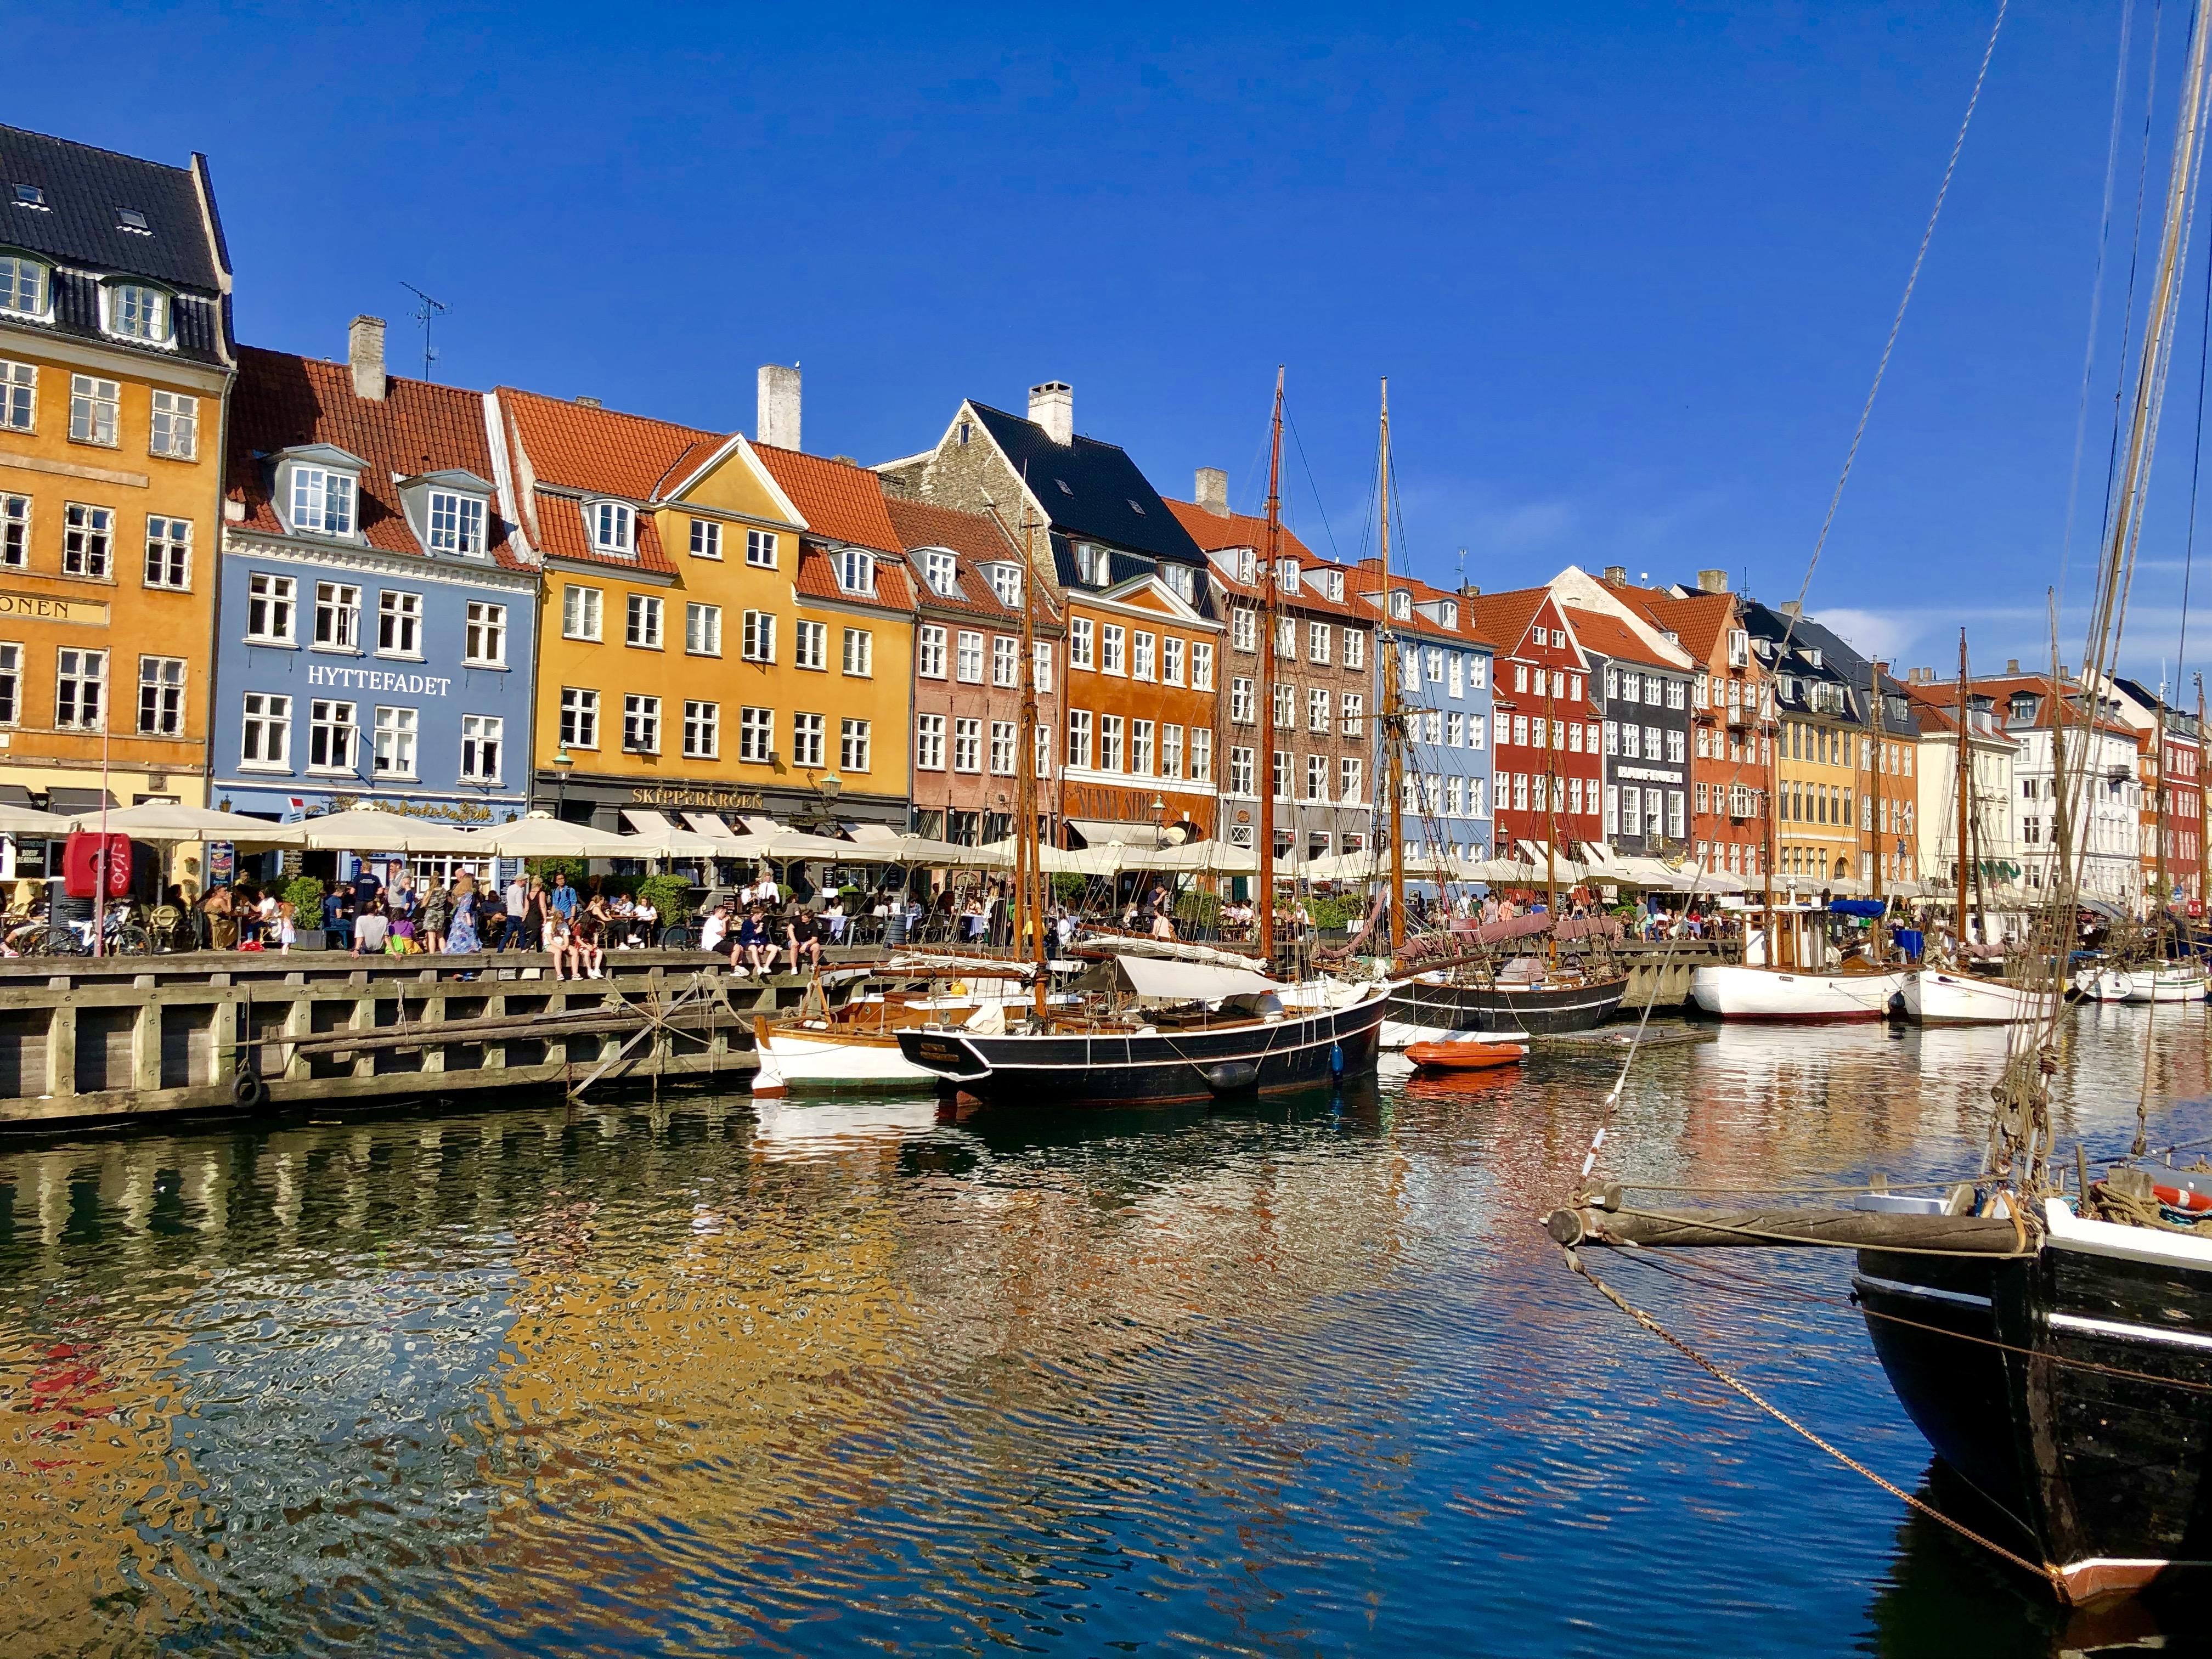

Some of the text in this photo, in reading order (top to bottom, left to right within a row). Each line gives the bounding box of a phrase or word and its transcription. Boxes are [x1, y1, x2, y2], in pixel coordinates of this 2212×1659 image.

[308, 665, 451, 696] HYTTEFADET
[1618, 766, 1683, 783] HAVFRUEN
[633, 788, 764, 809] SKIPPERKROEN
[1079, 788, 1121, 820] SUNNY
[1125, 792, 1154, 821] SIDE
